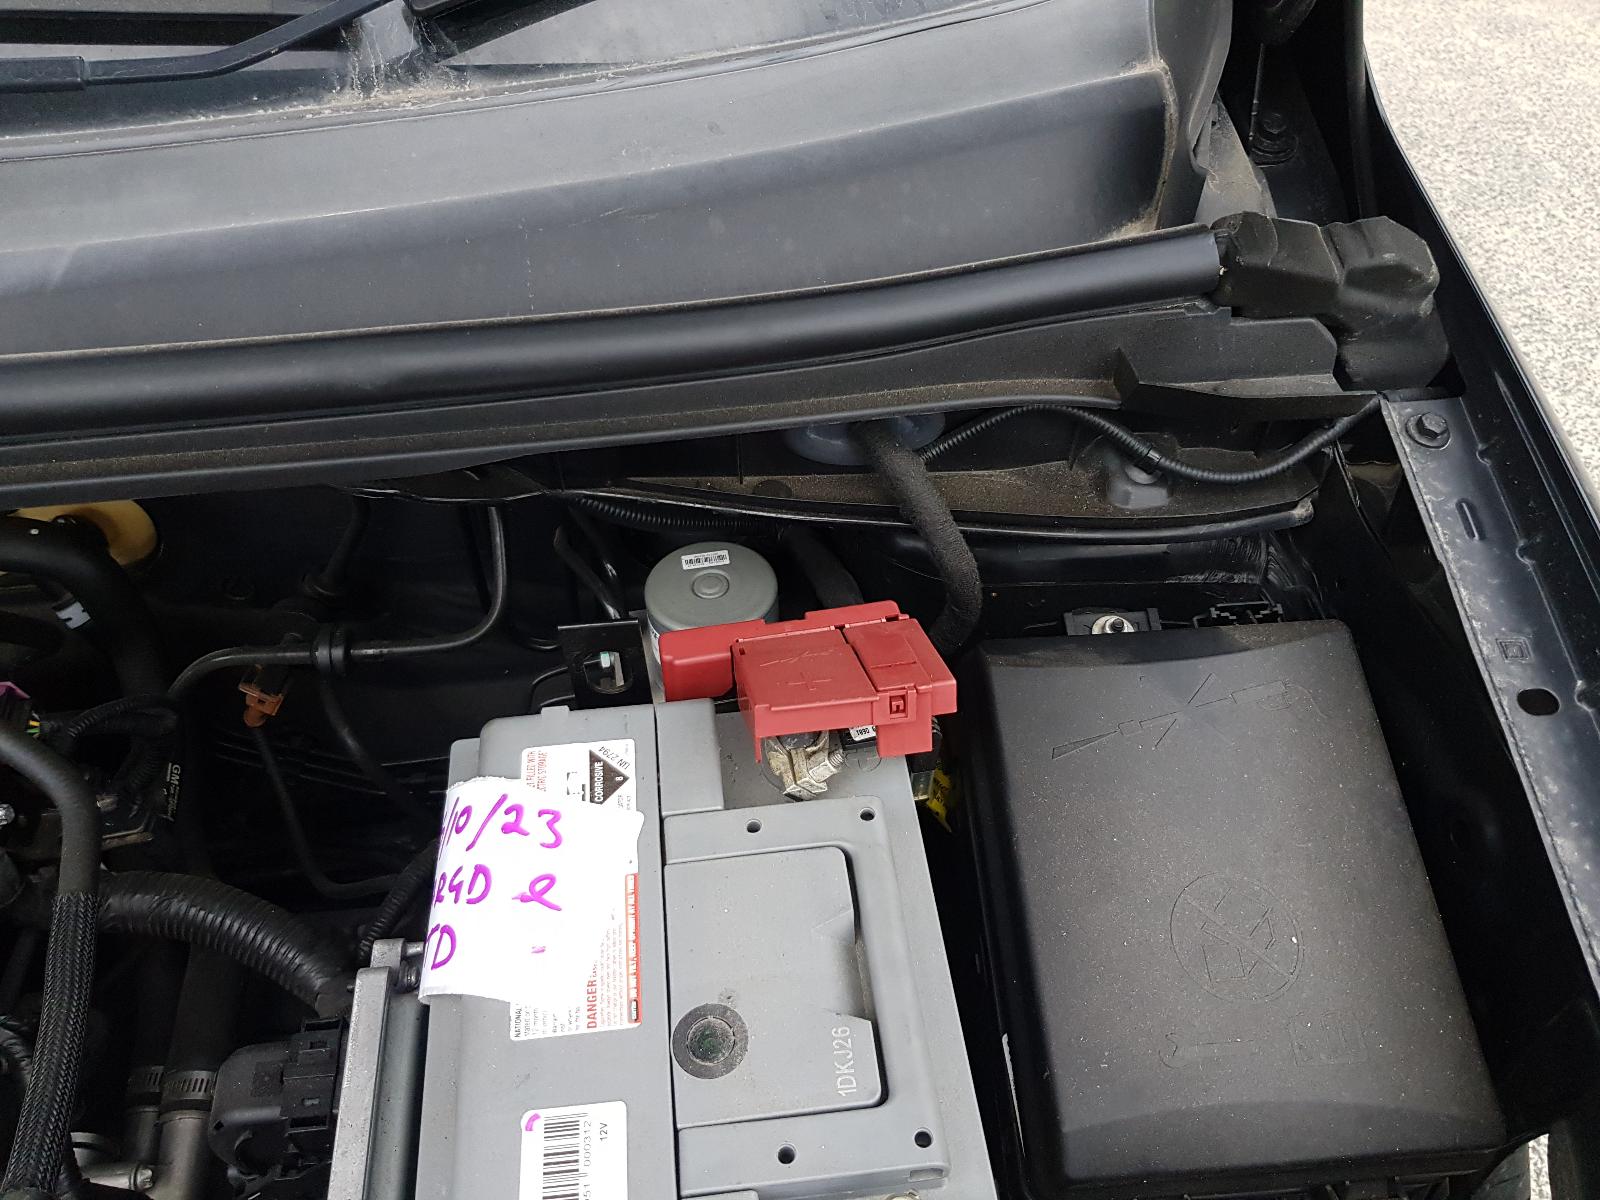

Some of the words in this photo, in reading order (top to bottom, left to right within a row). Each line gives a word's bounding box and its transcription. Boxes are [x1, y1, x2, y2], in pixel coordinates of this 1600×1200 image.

[598, 746, 620, 761] 2794
[617, 758, 631, 770] UN
[170, 764, 181, 785] GM
[595, 761, 604, 802] CORROSIVE
[587, 979, 598, 1030] DANGER
[514, 1008, 522, 1038] NATIONAL
[831, 1026, 857, 1097] 1DKJ26
[583, 1121, 592, 1167] 000312
[599, 1122, 608, 1142] 12V
